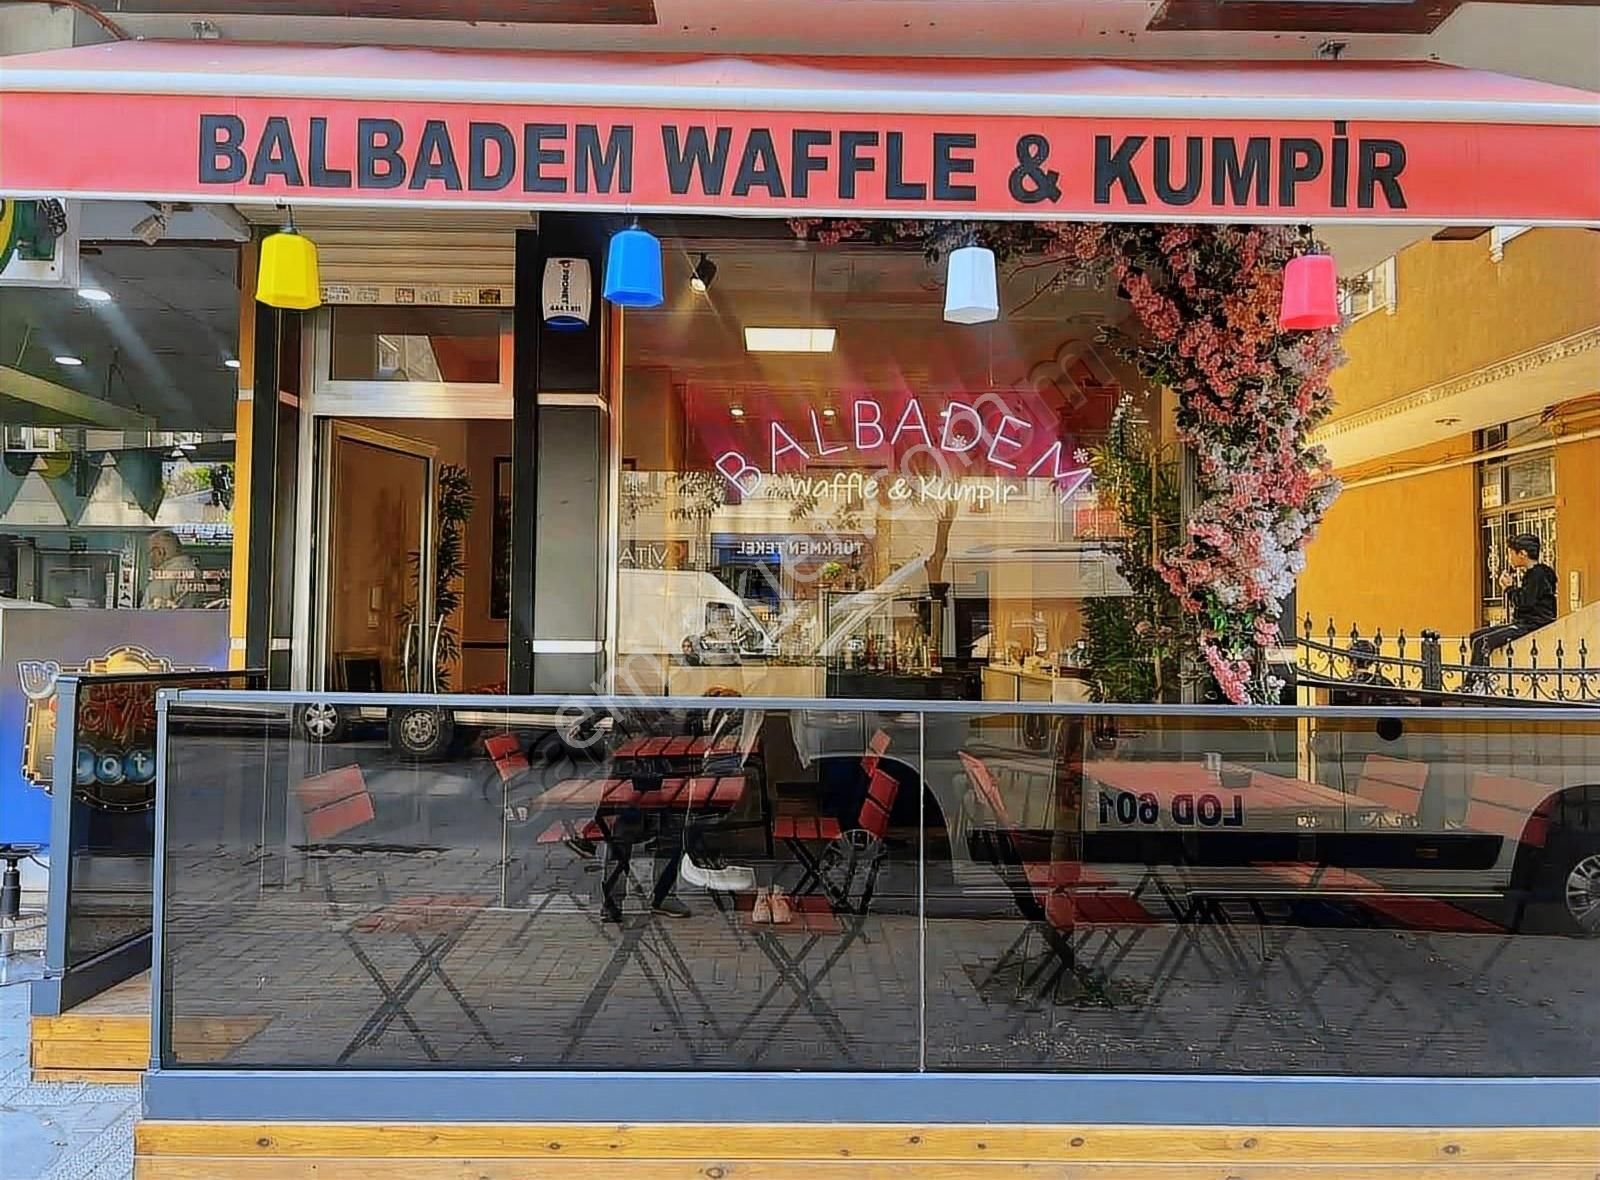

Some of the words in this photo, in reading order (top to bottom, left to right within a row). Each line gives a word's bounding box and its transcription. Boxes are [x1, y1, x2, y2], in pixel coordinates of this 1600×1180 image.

[199, 114, 633, 193] BALBADEM
[662, 125, 976, 202] WAFFLE
[1008, 134, 1062, 203] &
[1094, 119, 1408, 209] KUMPİR
[715, 399, 1092, 502] BALBADEM
[887, 478, 913, 499] &
